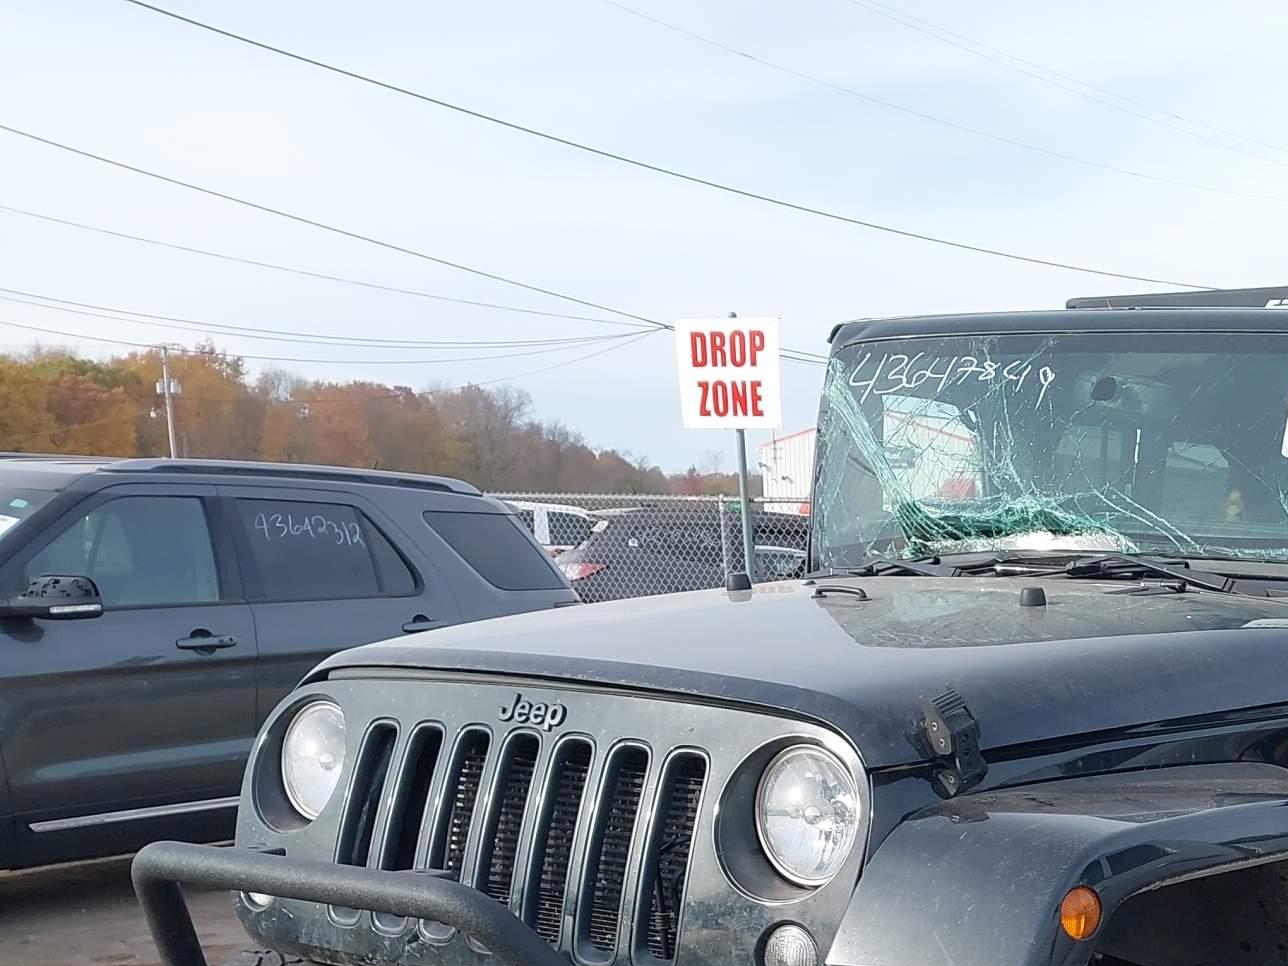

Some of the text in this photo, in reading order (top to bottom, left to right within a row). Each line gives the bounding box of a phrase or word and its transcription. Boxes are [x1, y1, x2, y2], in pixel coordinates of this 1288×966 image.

[690, 330, 765, 367] DROP
[697, 380, 764, 417] ZONE
[849, 351, 1056, 410] 43647849
[498, 692, 568, 732] Jeep
